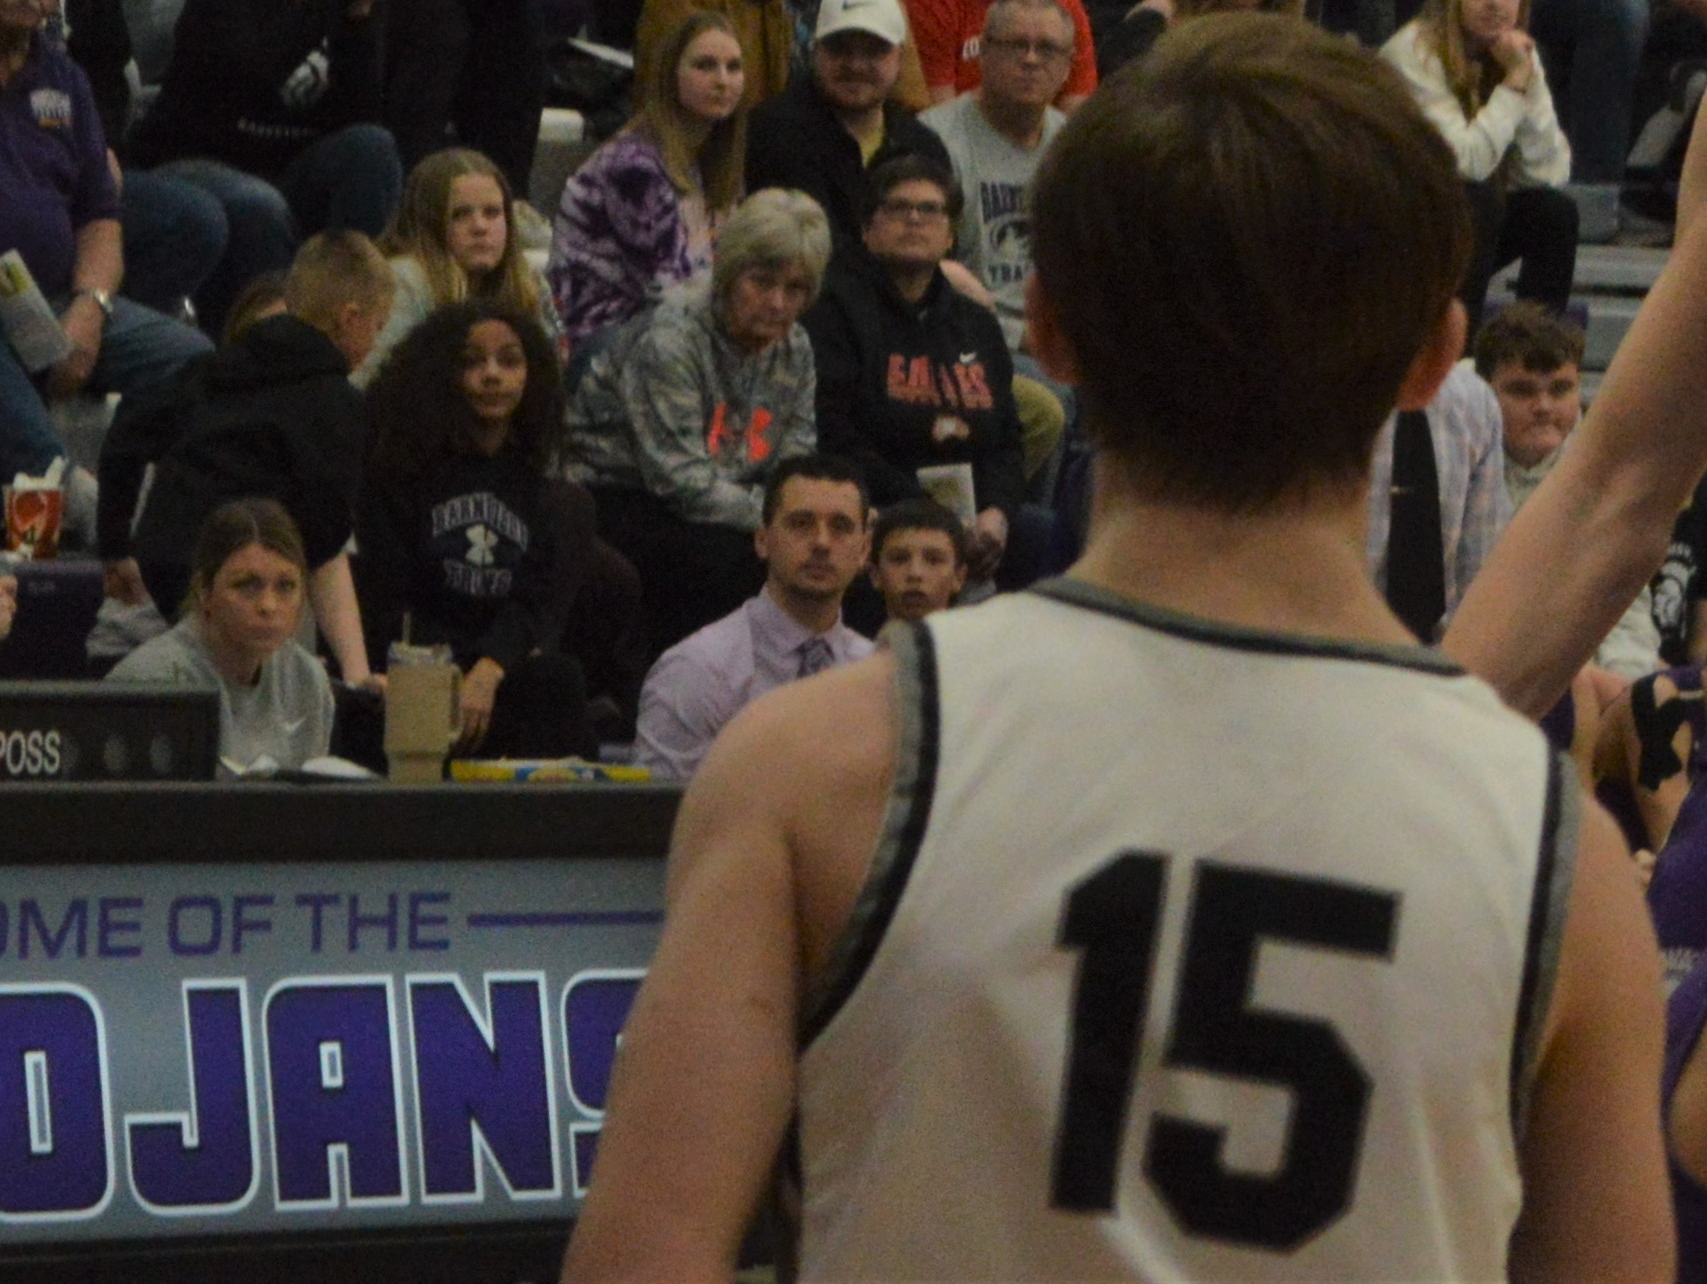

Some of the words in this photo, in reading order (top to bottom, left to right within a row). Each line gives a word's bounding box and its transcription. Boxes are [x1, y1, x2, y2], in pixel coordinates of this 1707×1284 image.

[0, 896, 144, 960] ME
[167, 894, 275, 956] OF
[295, 892, 450, 954] THE
[1047, 845, 1404, 1257] 15
